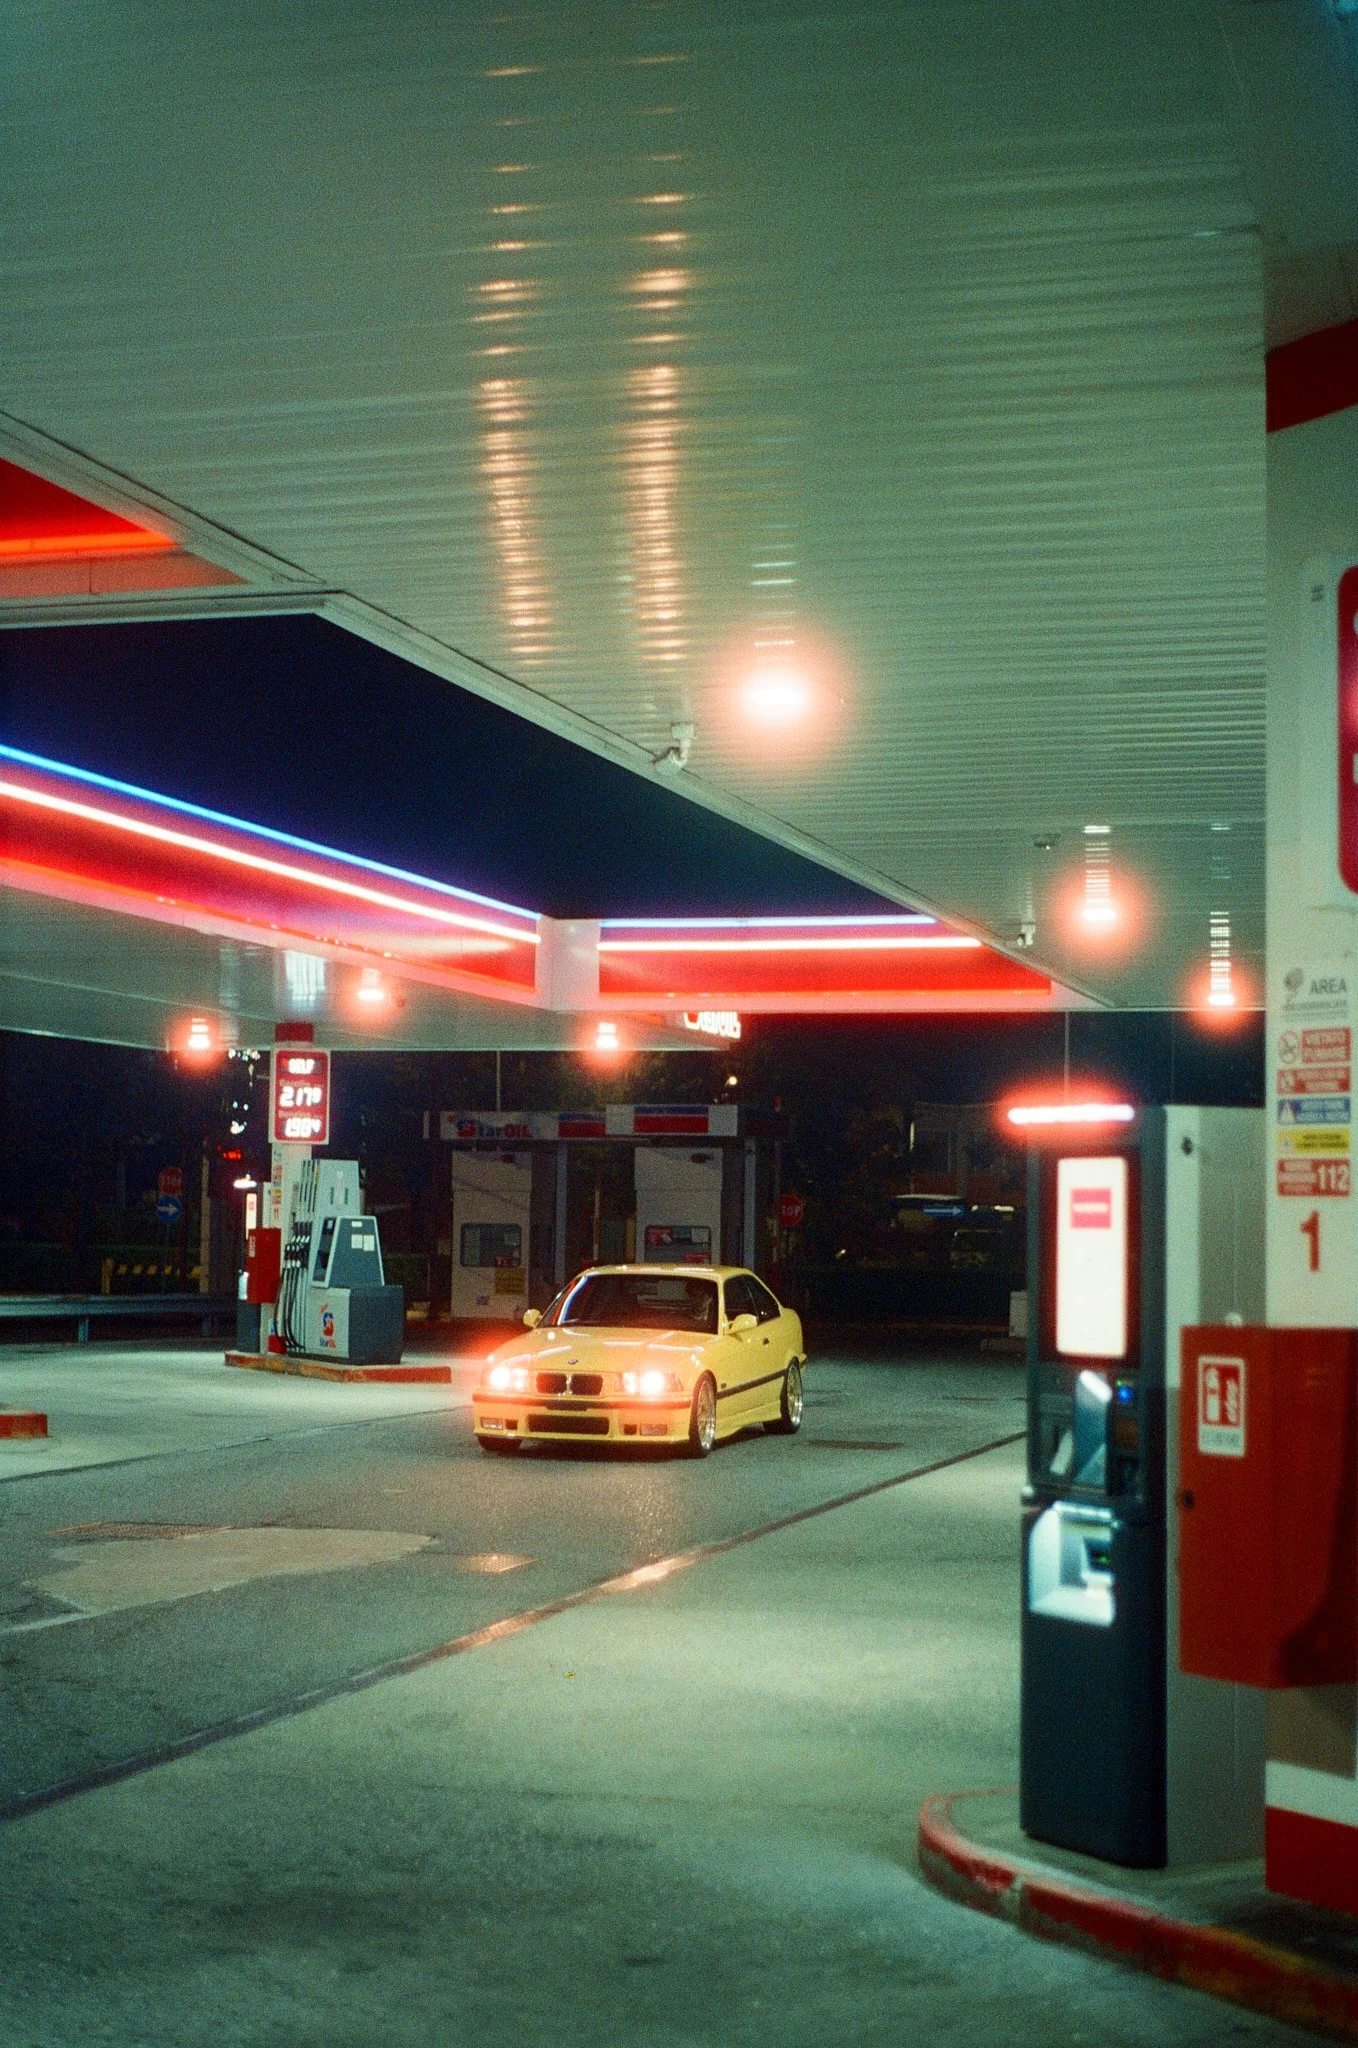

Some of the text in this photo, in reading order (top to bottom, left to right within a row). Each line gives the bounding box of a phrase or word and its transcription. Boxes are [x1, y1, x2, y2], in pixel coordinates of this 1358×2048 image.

[1309, 978, 1347, 995] AREA
[1318, 1164, 1349, 1191] 112
[1301, 1210, 1320, 1272] 1
